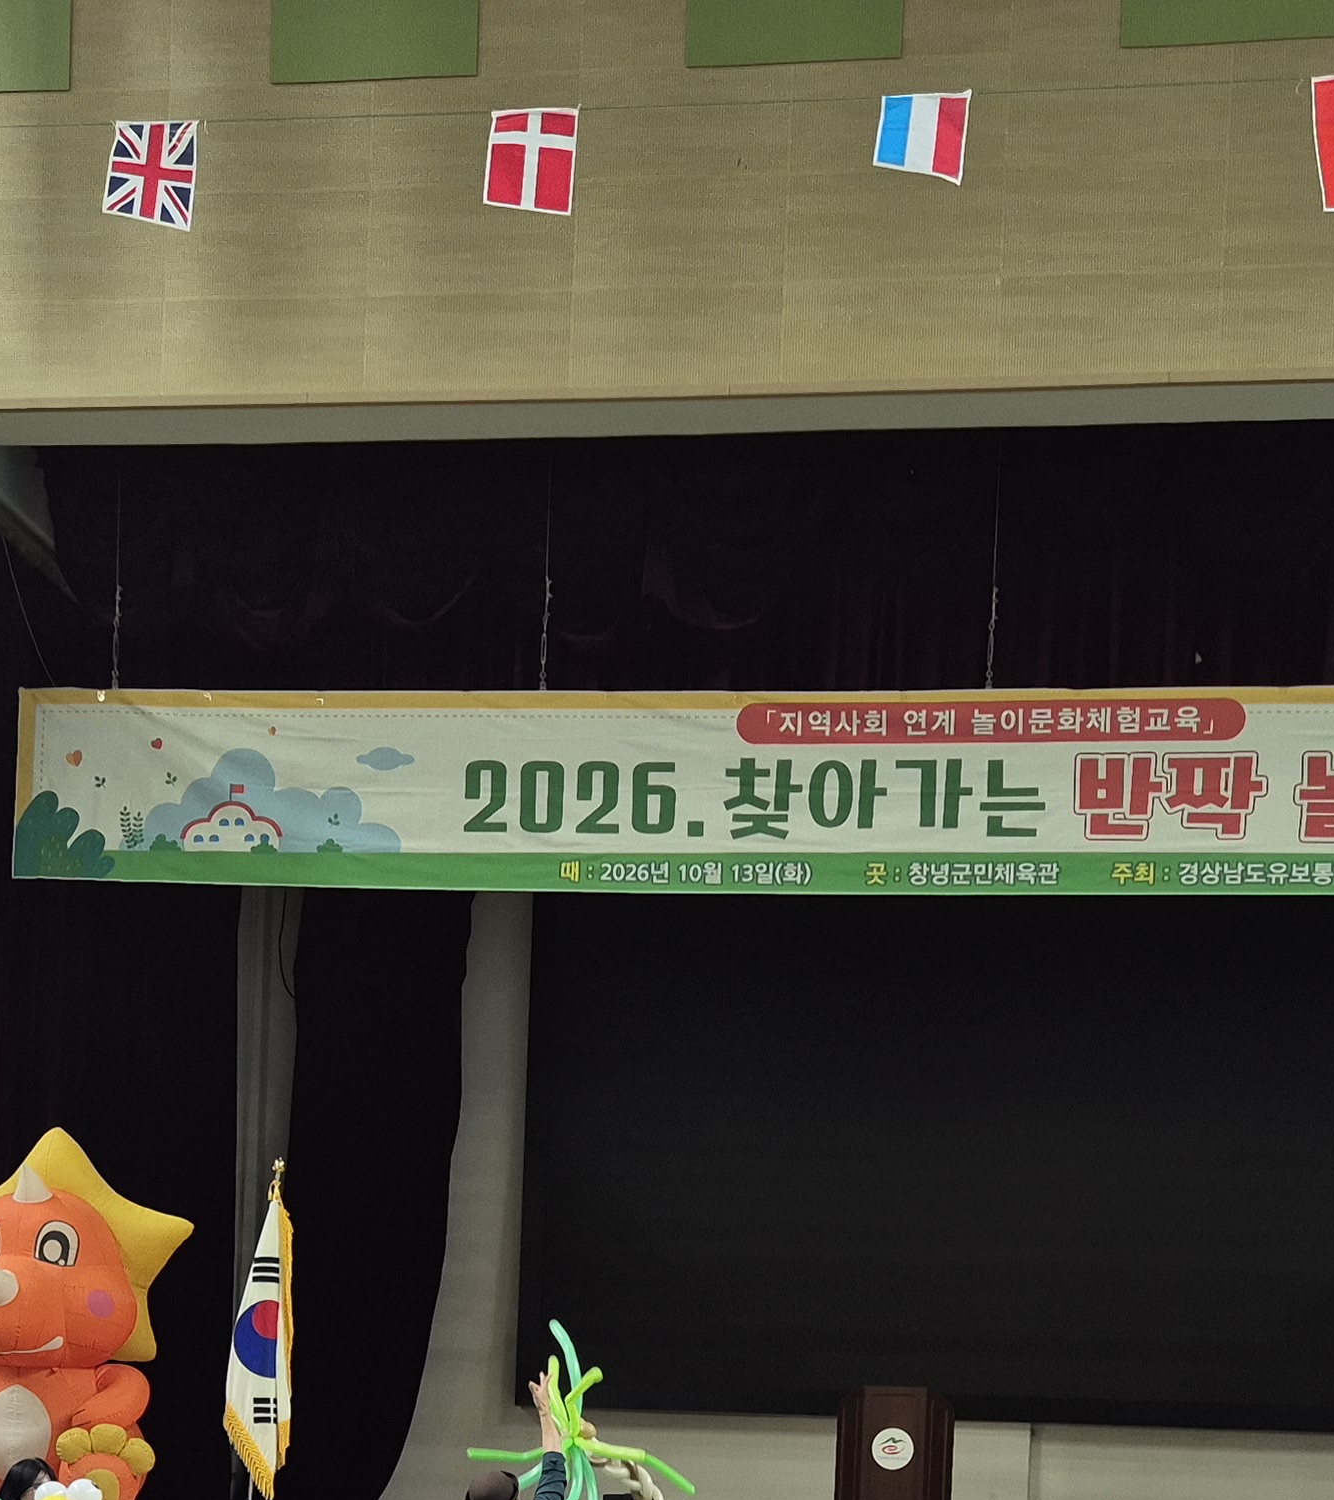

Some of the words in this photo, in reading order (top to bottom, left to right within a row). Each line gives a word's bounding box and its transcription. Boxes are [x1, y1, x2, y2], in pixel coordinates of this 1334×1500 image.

[903, 709, 956, 737] 연계
[1074, 751, 1267, 840] 반짝
[560, 860, 580, 883] 때
[600, 861, 670, 884] 2026년
[679, 862, 723, 885] 10월
[731, 862, 812, 885] 13일(화)
[866, 863, 887, 885] 곳
[908, 862, 1059, 886] 창녕군민체육관
[1111, 862, 1155, 885] 주최
